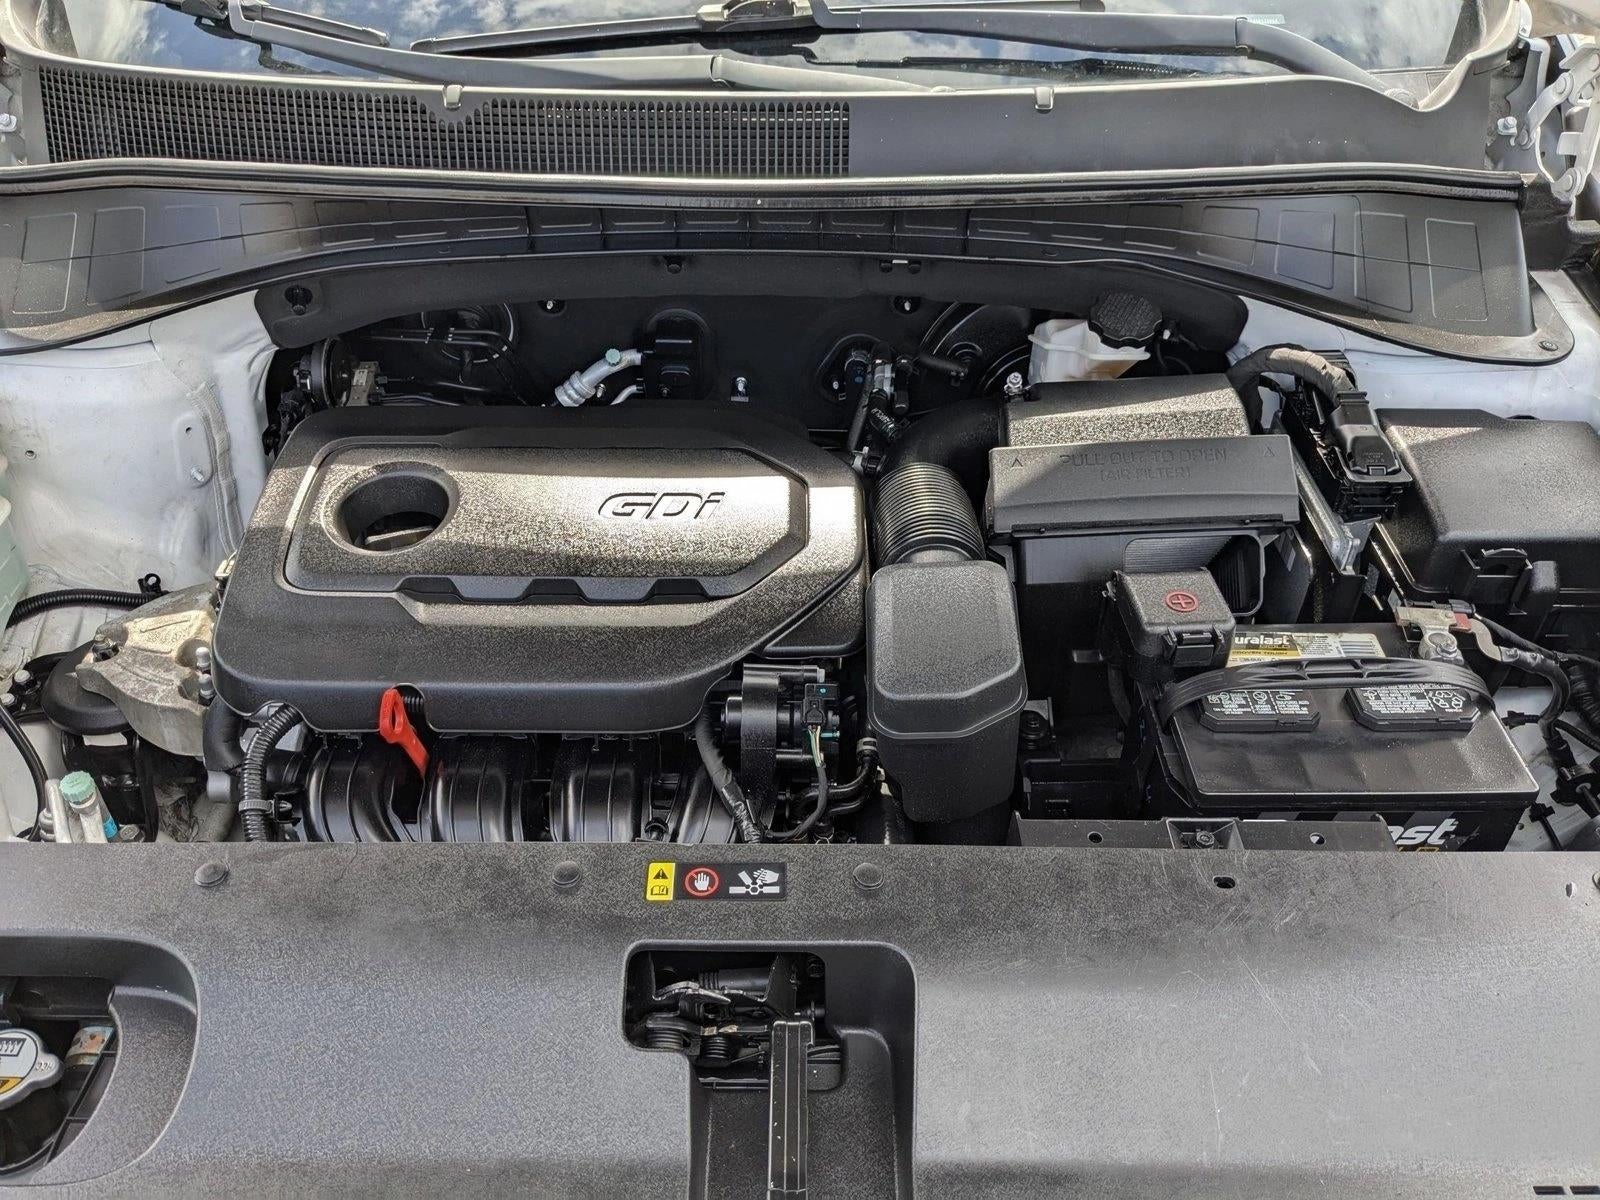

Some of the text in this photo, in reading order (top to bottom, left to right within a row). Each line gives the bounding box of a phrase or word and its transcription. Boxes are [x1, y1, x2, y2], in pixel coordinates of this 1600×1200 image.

[1059, 448, 1227, 467] PULL OUT TO OPEN
[1234, 634, 1290, 645] uralast
